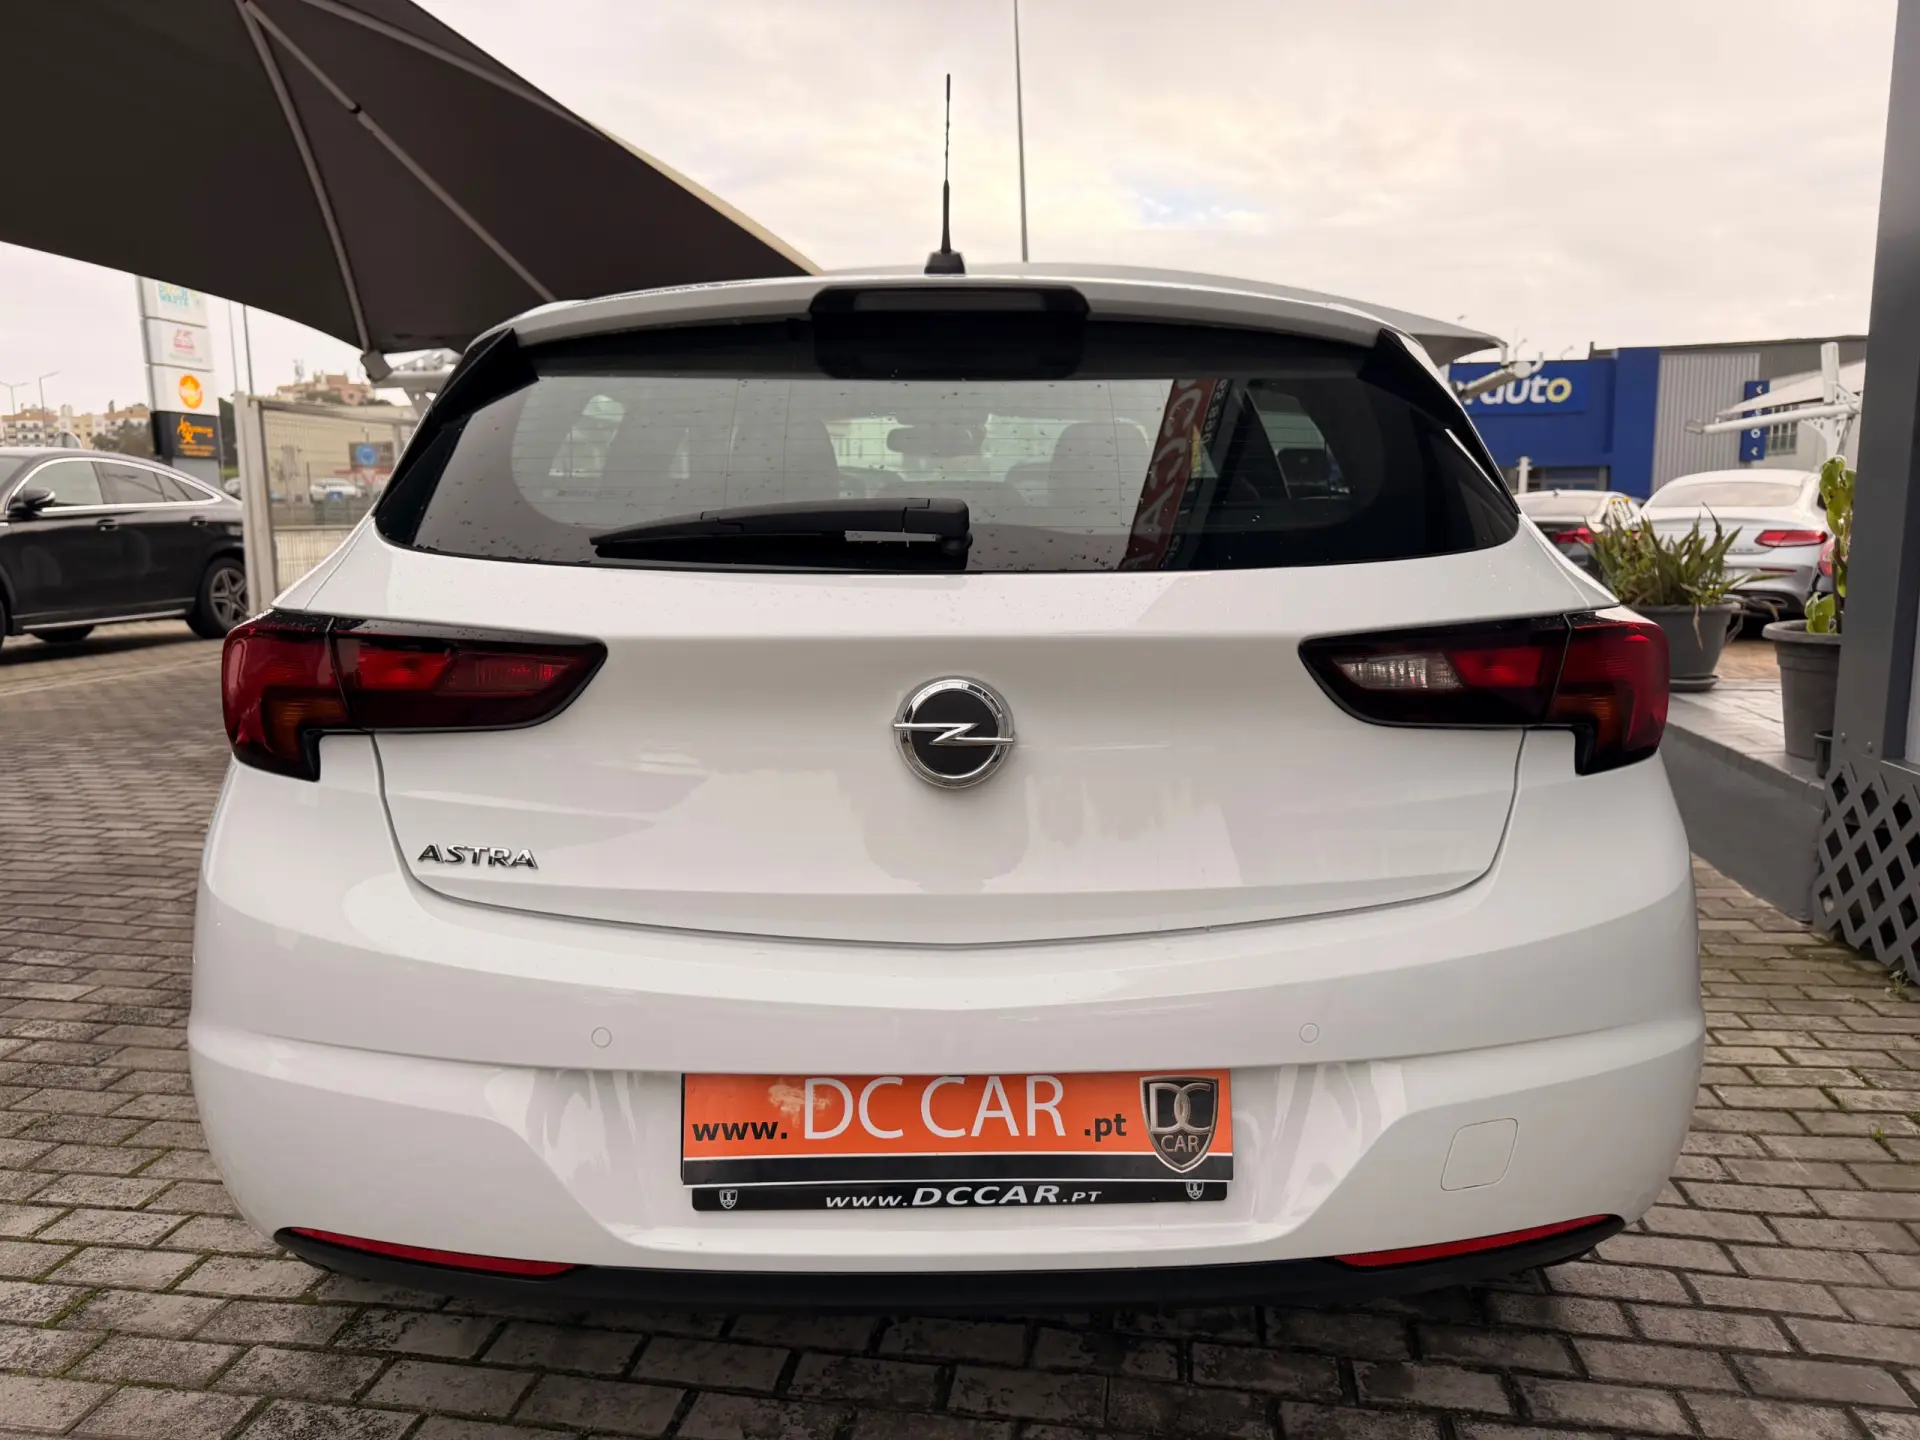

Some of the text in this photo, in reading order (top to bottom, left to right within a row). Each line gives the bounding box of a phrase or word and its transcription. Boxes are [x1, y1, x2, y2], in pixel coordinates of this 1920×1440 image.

[1463, 374, 1573, 405] auto
[417, 842, 539, 870] ASTRA
[692, 1074, 1127, 1143] www. DC CAR .pt
[1149, 1082, 1212, 1135] DC
[1160, 1135, 1200, 1153] CAR
[826, 1185, 1102, 1208] www.DCCAR.PT
